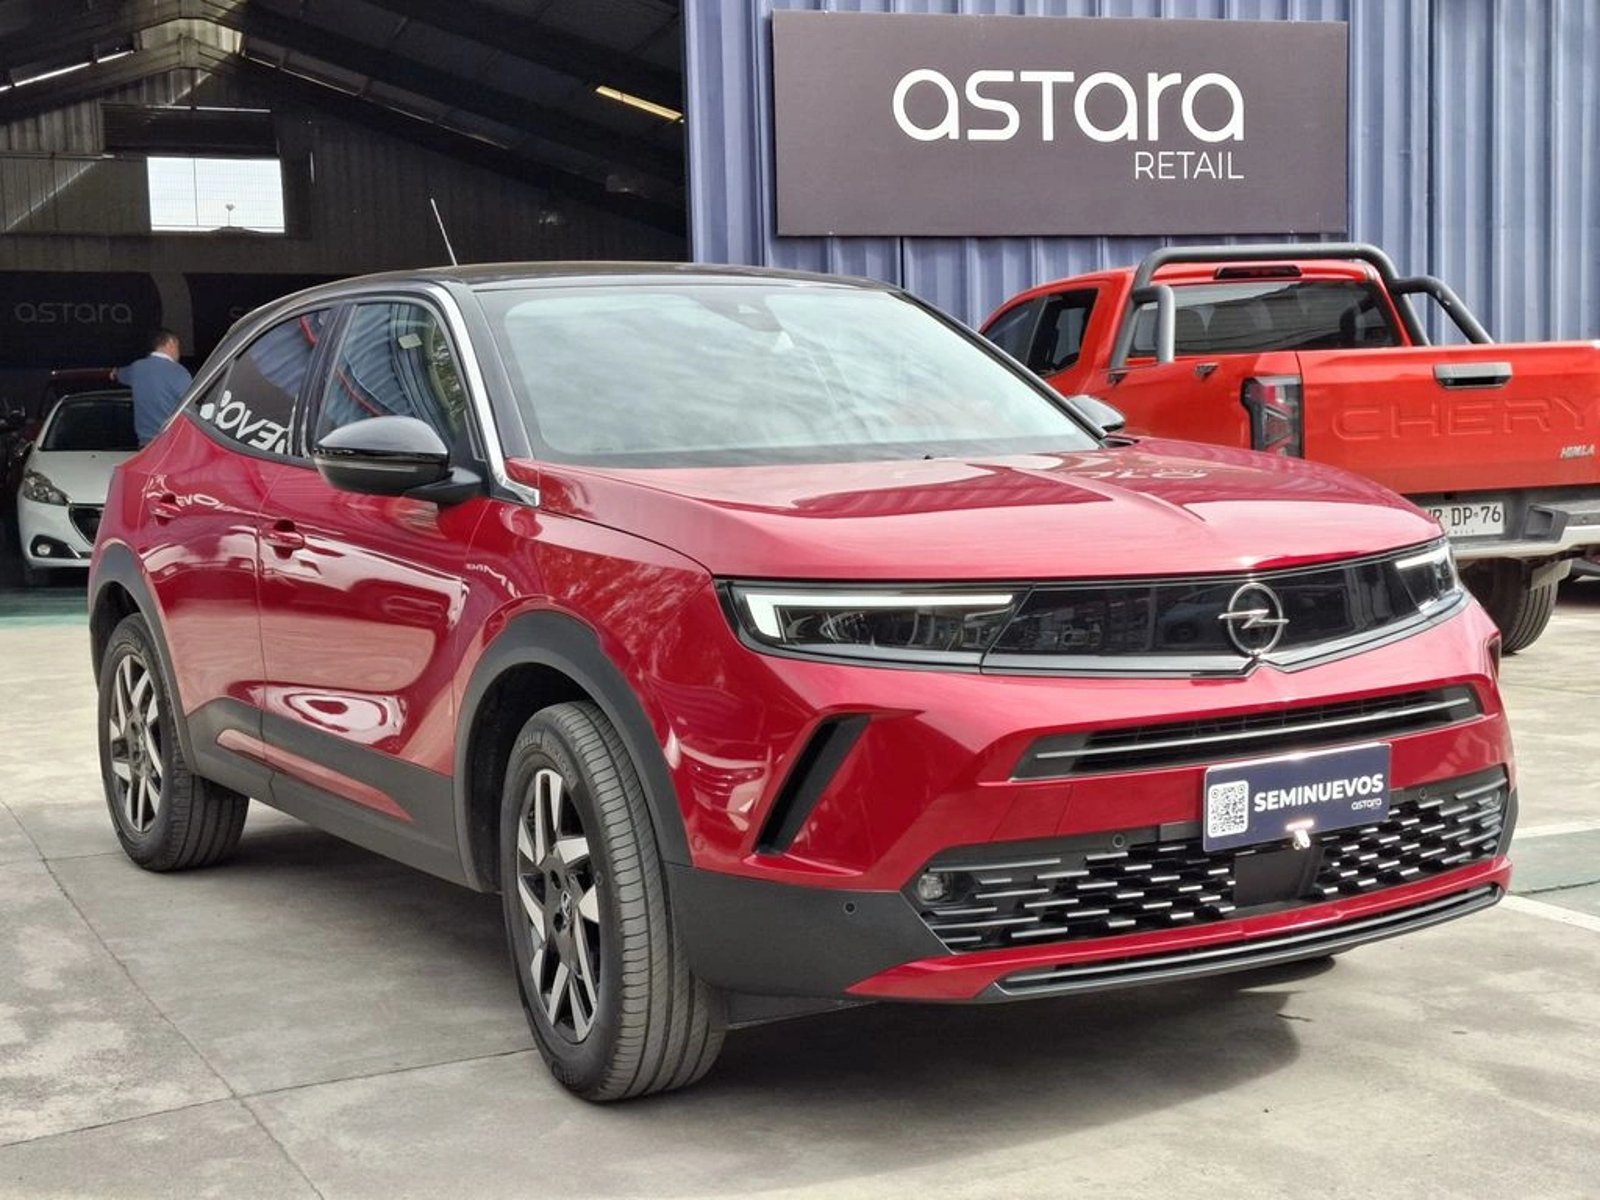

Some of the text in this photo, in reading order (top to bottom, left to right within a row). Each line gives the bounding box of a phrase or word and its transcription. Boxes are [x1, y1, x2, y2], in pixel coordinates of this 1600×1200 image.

[892, 68, 1245, 143] astara
[1135, 151, 1245, 180] RETAIL
[14, 302, 133, 324] astara
[1331, 397, 1599, 441] CHERY
[1253, 773, 1384, 812] SEMINUEVOS
